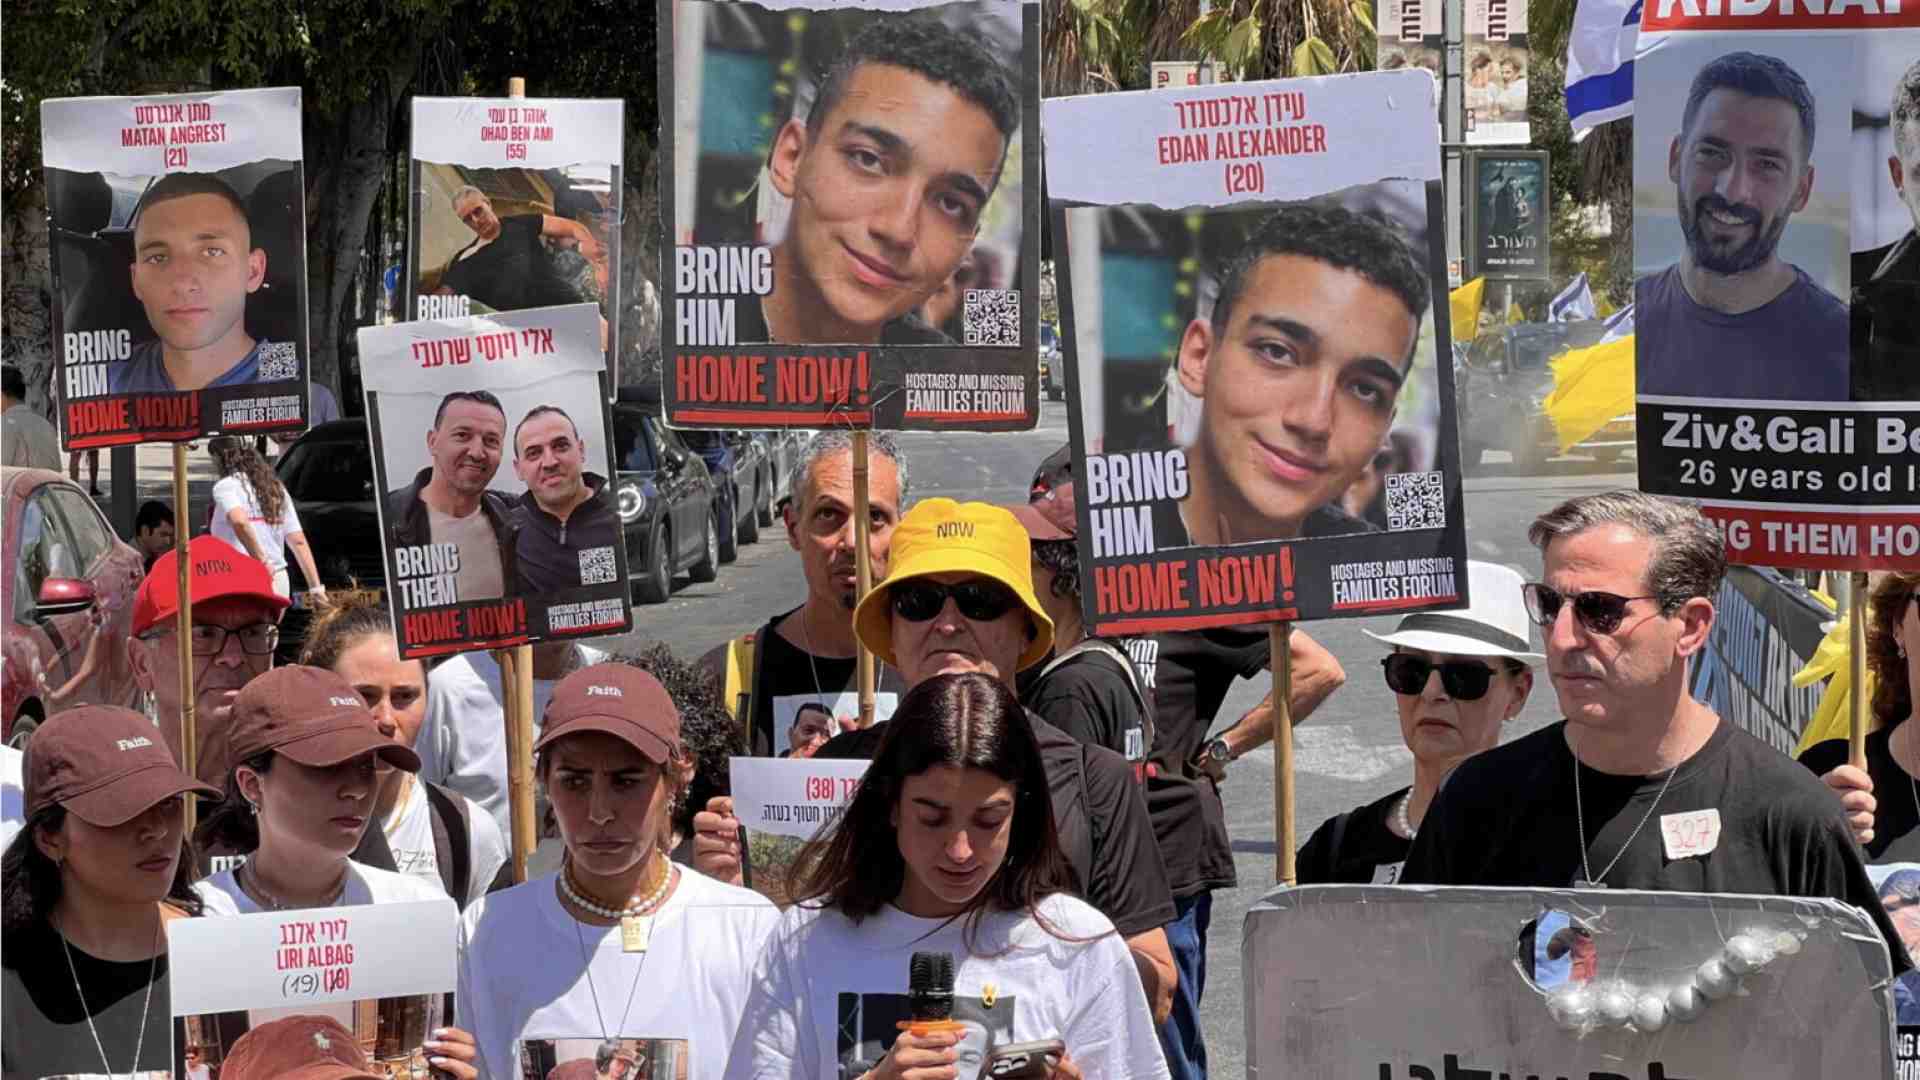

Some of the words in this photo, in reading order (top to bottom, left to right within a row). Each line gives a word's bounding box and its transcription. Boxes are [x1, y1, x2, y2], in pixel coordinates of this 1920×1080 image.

[1174, 96, 1258, 129] אלכסנדר
[1264, 92, 1305, 125] עידן
[121, 127, 166, 147] MATAN
[170, 124, 226, 144] ANGREST
[481, 126, 508, 142] OHAD
[511, 126, 530, 142] BEN
[533, 126, 554, 141] AMI
[1158, 134, 1209, 164] EDAN
[1215, 125, 1327, 160] ALEXANDER
[164, 147, 187, 168] (21)
[506, 144, 527, 160] (55)
[1225, 161, 1264, 195] (20)
[675, 246, 773, 295] BRING
[418, 294, 470, 321] BRING
[675, 298, 736, 346] HIM
[63, 329, 131, 365] BRING
[412, 336, 471, 369] שרעבי
[476, 331, 517, 361] ויוסי
[522, 328, 555, 354] אלי
[65, 363, 108, 399] HIM
[675, 356, 767, 405] HOME
[776, 351, 871, 405] NOW!
[905, 373, 956, 390] HOSTAGES
[958, 374, 978, 390] AND
[980, 374, 1025, 391] MISSING
[68, 398, 129, 435] HOME
[135, 391, 199, 431] NOW!
[222, 408, 265, 425] FAMILIES
[266, 405, 300, 422] FORUM
[906, 390, 970, 413] FAMILIES
[974, 391, 1025, 414] FORUM
[1661, 411, 1855, 454] Ziv&Gali
[1086, 449, 1188, 504] BRING
[1680, 458, 1716, 486] 26
[1730, 467, 1823, 494] years
[1838, 465, 1891, 492] old
[937, 521, 974, 538] NOW
[1090, 505, 1154, 559] HIM
[1761, 521, 1857, 556] THEM
[395, 543, 460, 578] BRING
[1331, 561, 1383, 581] HOSTAGES
[1385, 560, 1406, 577] AND
[1407, 557, 1454, 575] MISSING
[398, 573, 457, 609] THEM
[1095, 561, 1190, 614] HOME
[1198, 546, 1296, 609] NOW!
[1332, 578, 1399, 604] FAMILIES
[1402, 573, 1456, 599] FORUM
[404, 609, 462, 645] HOME
[466, 600, 527, 637] NOW!
[549, 611, 590, 632] FAMILIES
[586, 684, 622, 697] Faith
[806, 776, 834, 801] (38)
[794, 805, 820, 824] חטוף
[280, 922, 316, 945] אלבג
[320, 918, 348, 941] לירי
[277, 948, 303, 970] LIRI
[308, 944, 353, 967] ALBAG
[282, 972, 319, 998] (19)
